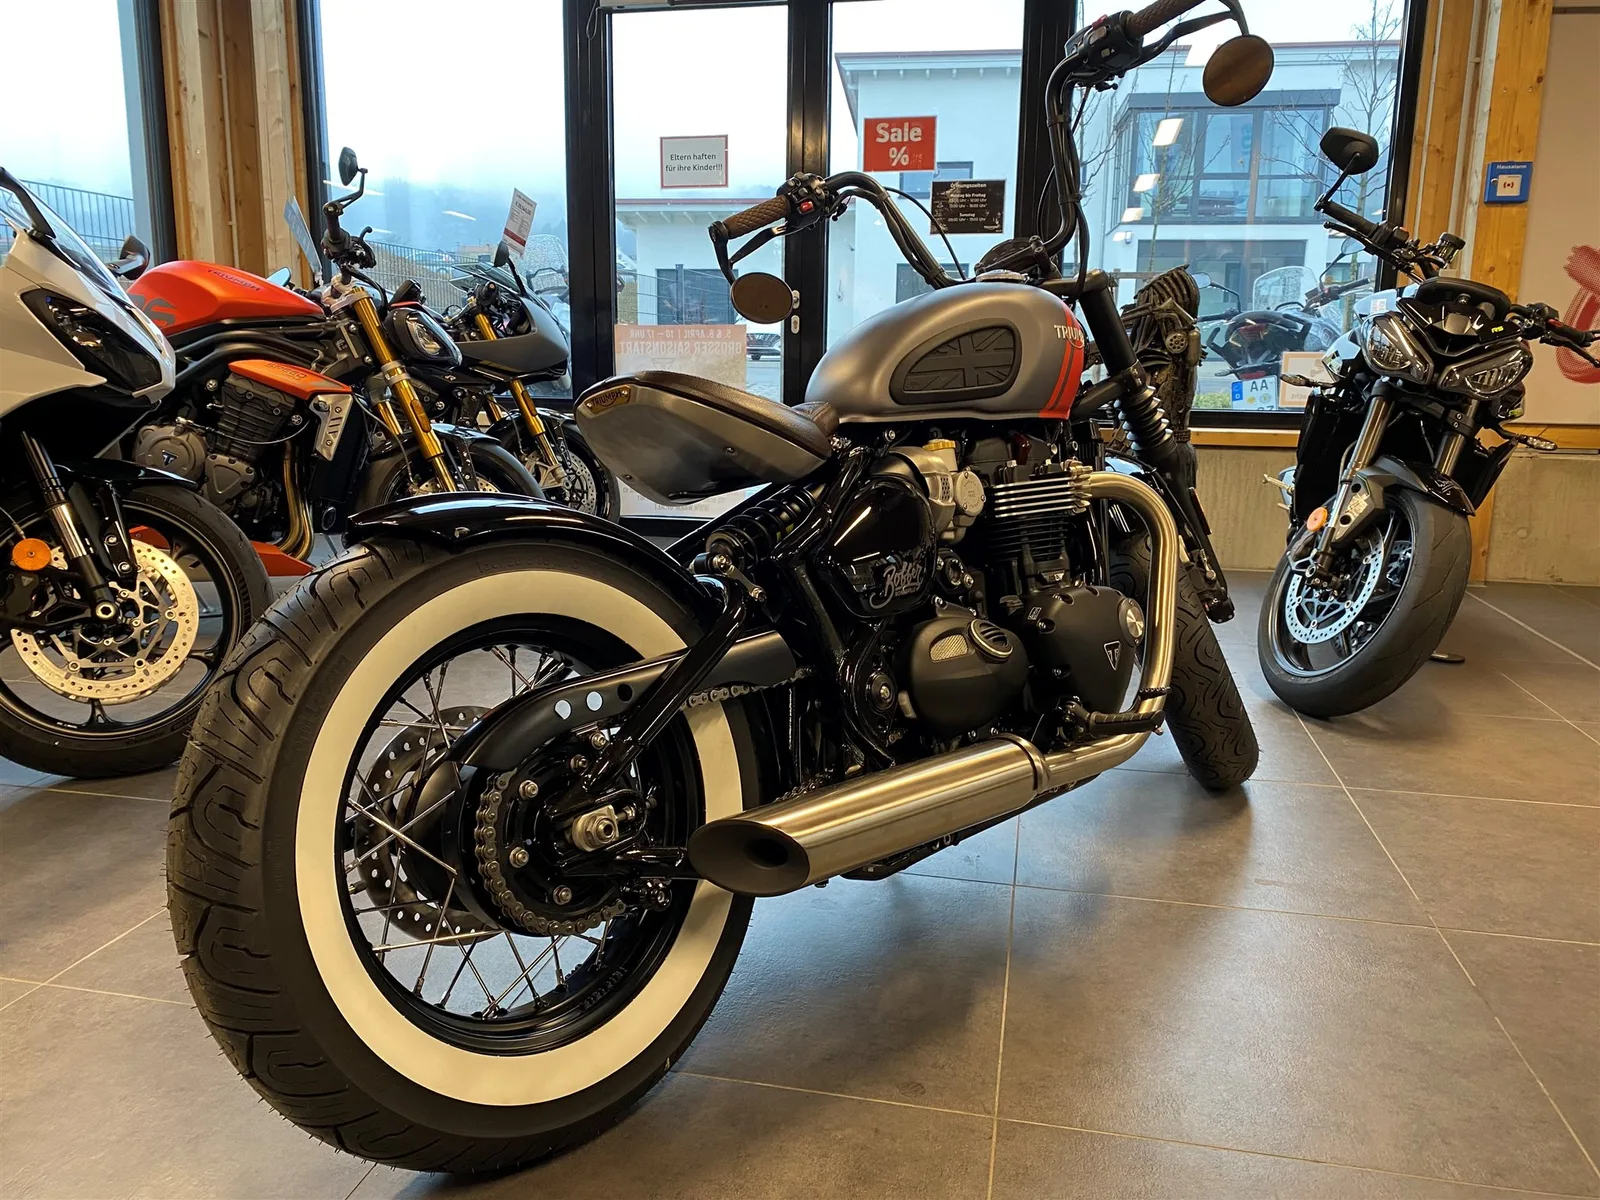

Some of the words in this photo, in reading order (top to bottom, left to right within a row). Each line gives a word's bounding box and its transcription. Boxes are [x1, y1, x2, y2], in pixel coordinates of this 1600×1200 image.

[875, 122, 922, 143] Sale
[670, 153, 692, 161] Eltern
[692, 152, 717, 160] haften
[888, 146, 910, 167] %
[665, 164, 676, 172] für
[677, 164, 692, 172] ihre
[692, 163, 723, 171] Kinder!!!
[207, 269, 261, 291] TRIUMPH
[1250, 379, 1269, 392] AA
[591, 390, 622, 406] TRIUMPH
[869, 561, 923, 609] Bobber
